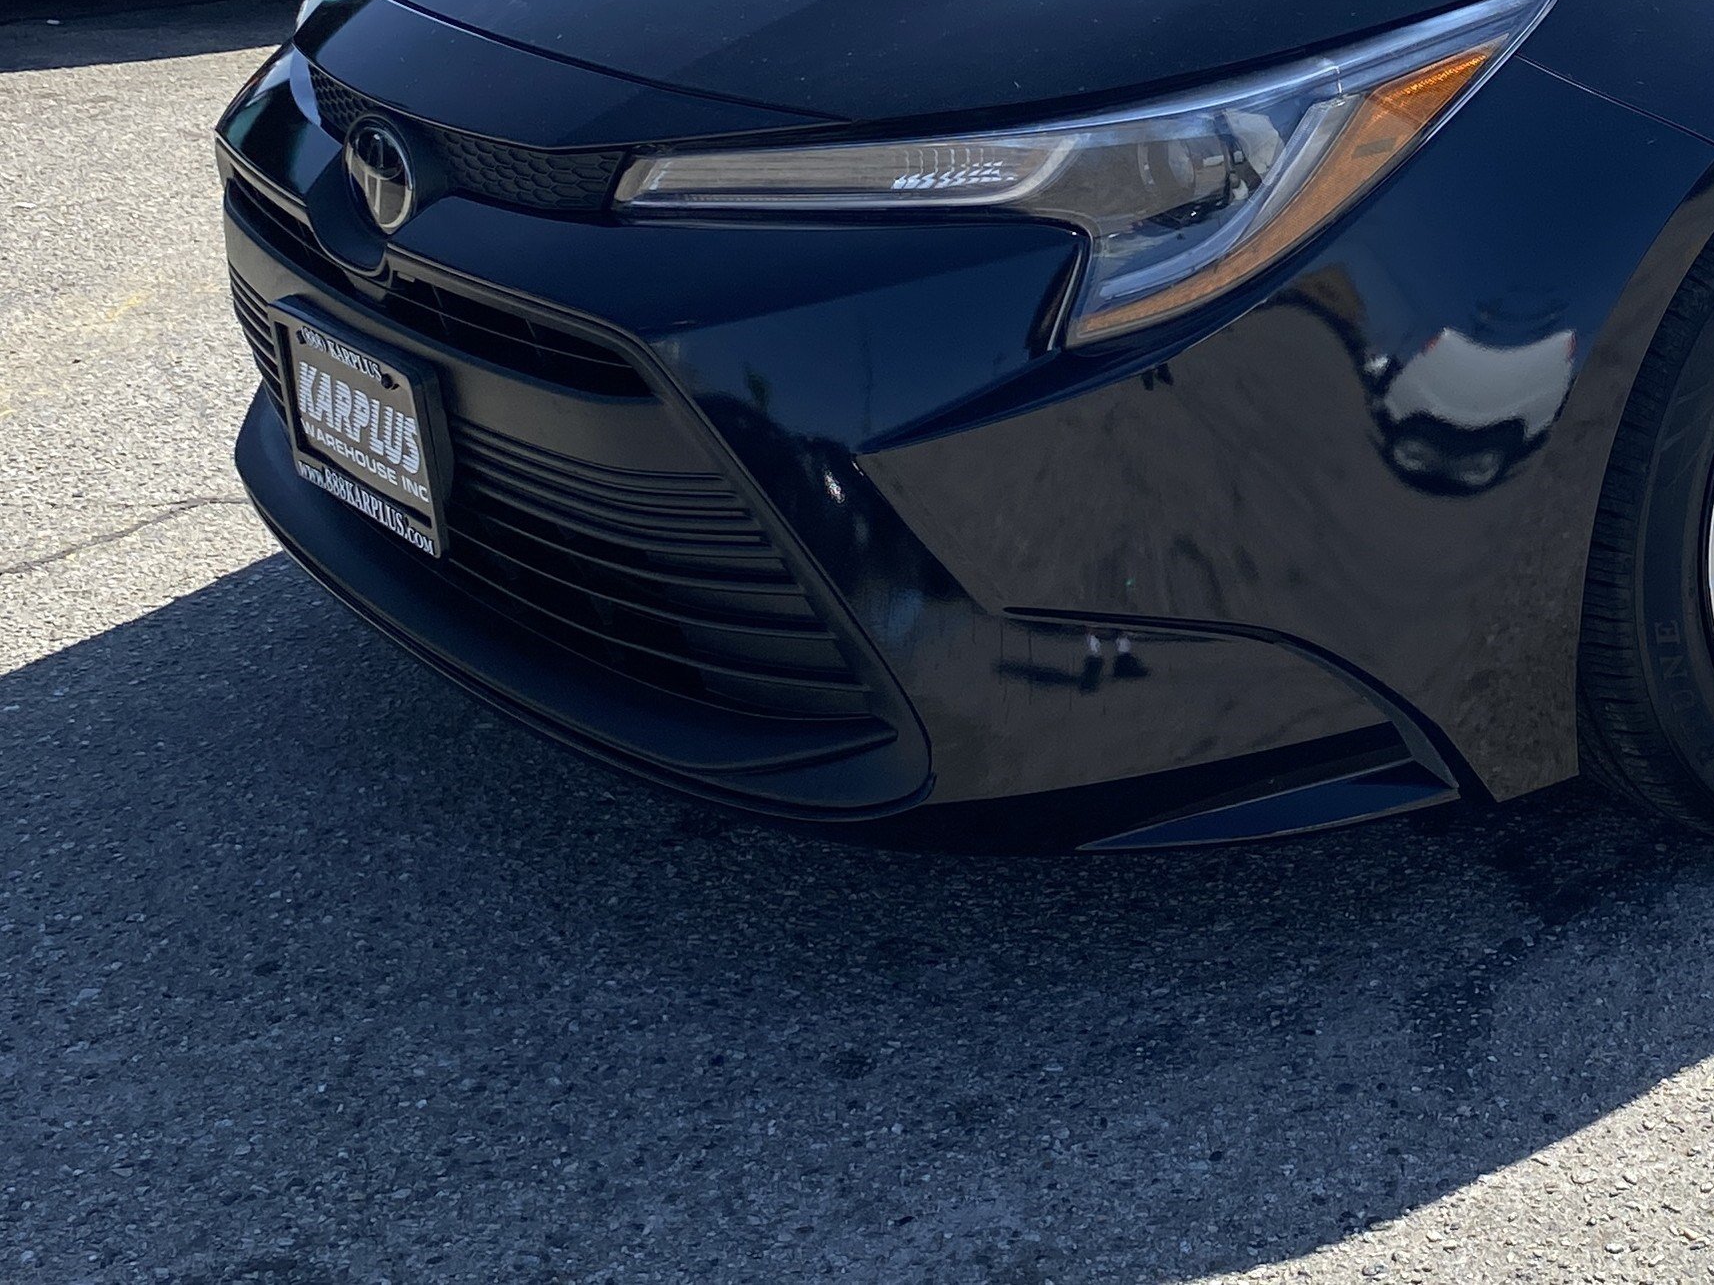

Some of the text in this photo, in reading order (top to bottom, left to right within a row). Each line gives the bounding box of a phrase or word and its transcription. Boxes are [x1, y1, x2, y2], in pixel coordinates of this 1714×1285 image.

[326, 338, 382, 385] KARPLUS
[299, 361, 420, 474] KARPLUS
[300, 417, 430, 503] WAREHOUSE INC
